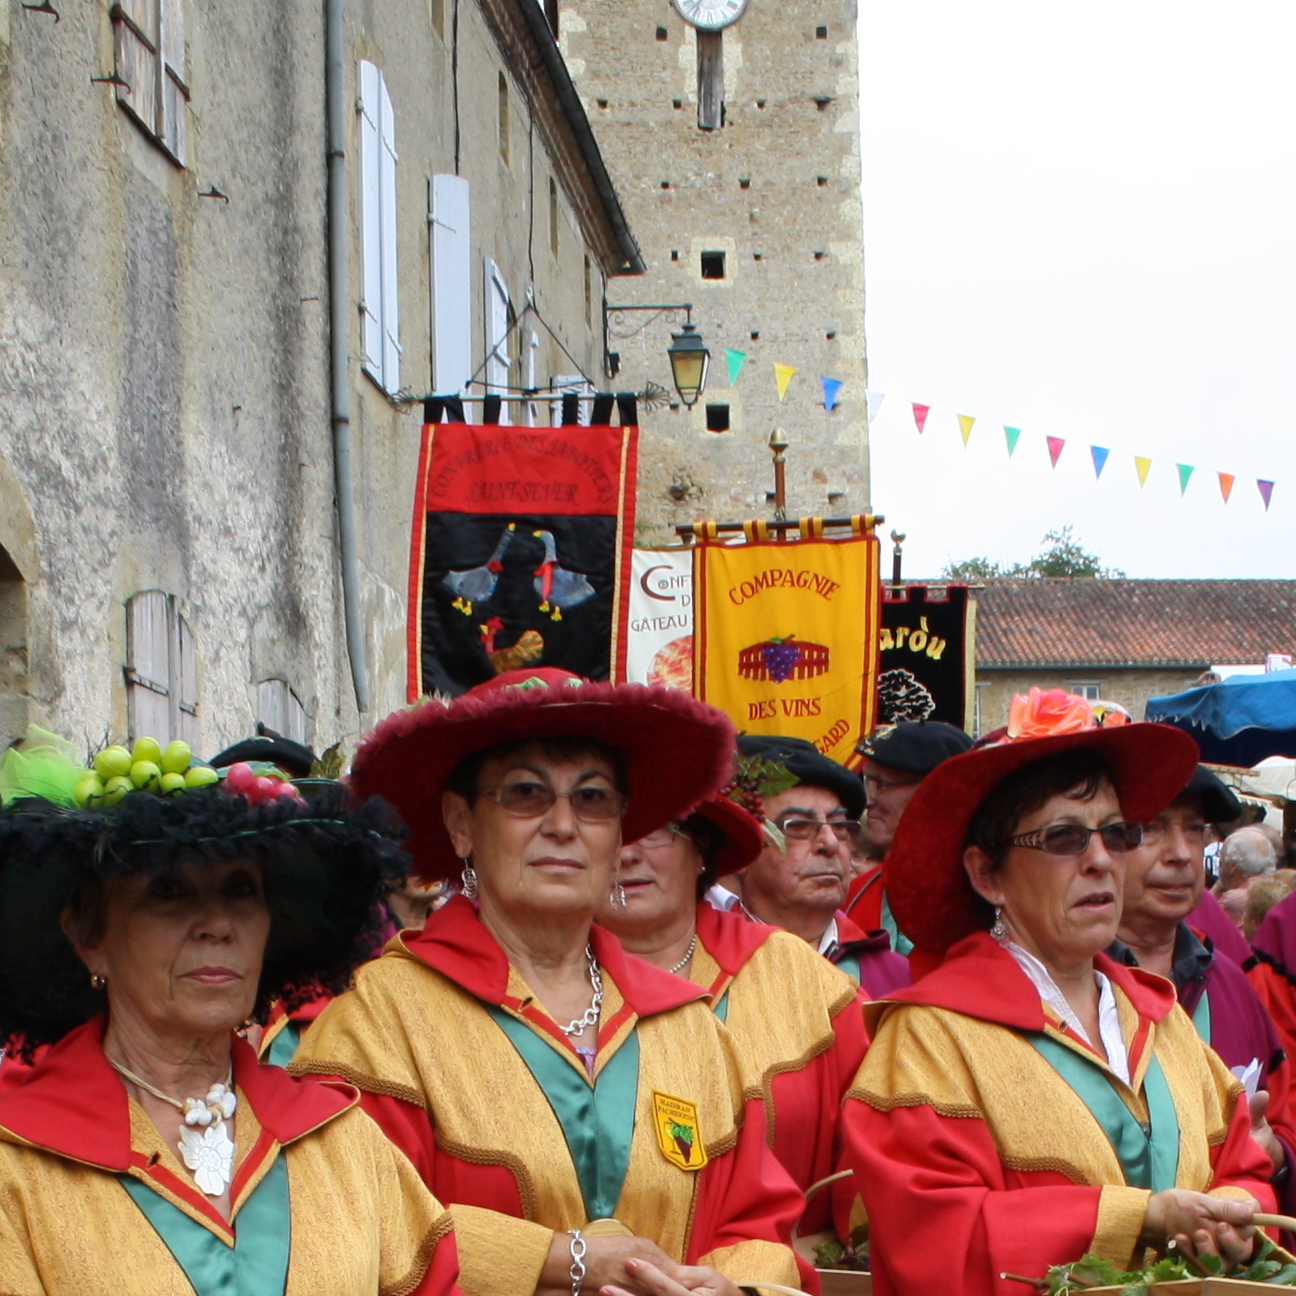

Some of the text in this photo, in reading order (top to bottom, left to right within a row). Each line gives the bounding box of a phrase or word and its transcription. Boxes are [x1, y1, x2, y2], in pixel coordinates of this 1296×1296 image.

[728, 569, 841, 606] COMPAGNIE
[630, 614, 688, 632] GÂTEAU
[748, 697, 822, 720] DES VINS
[813, 718, 851, 755] GARD
